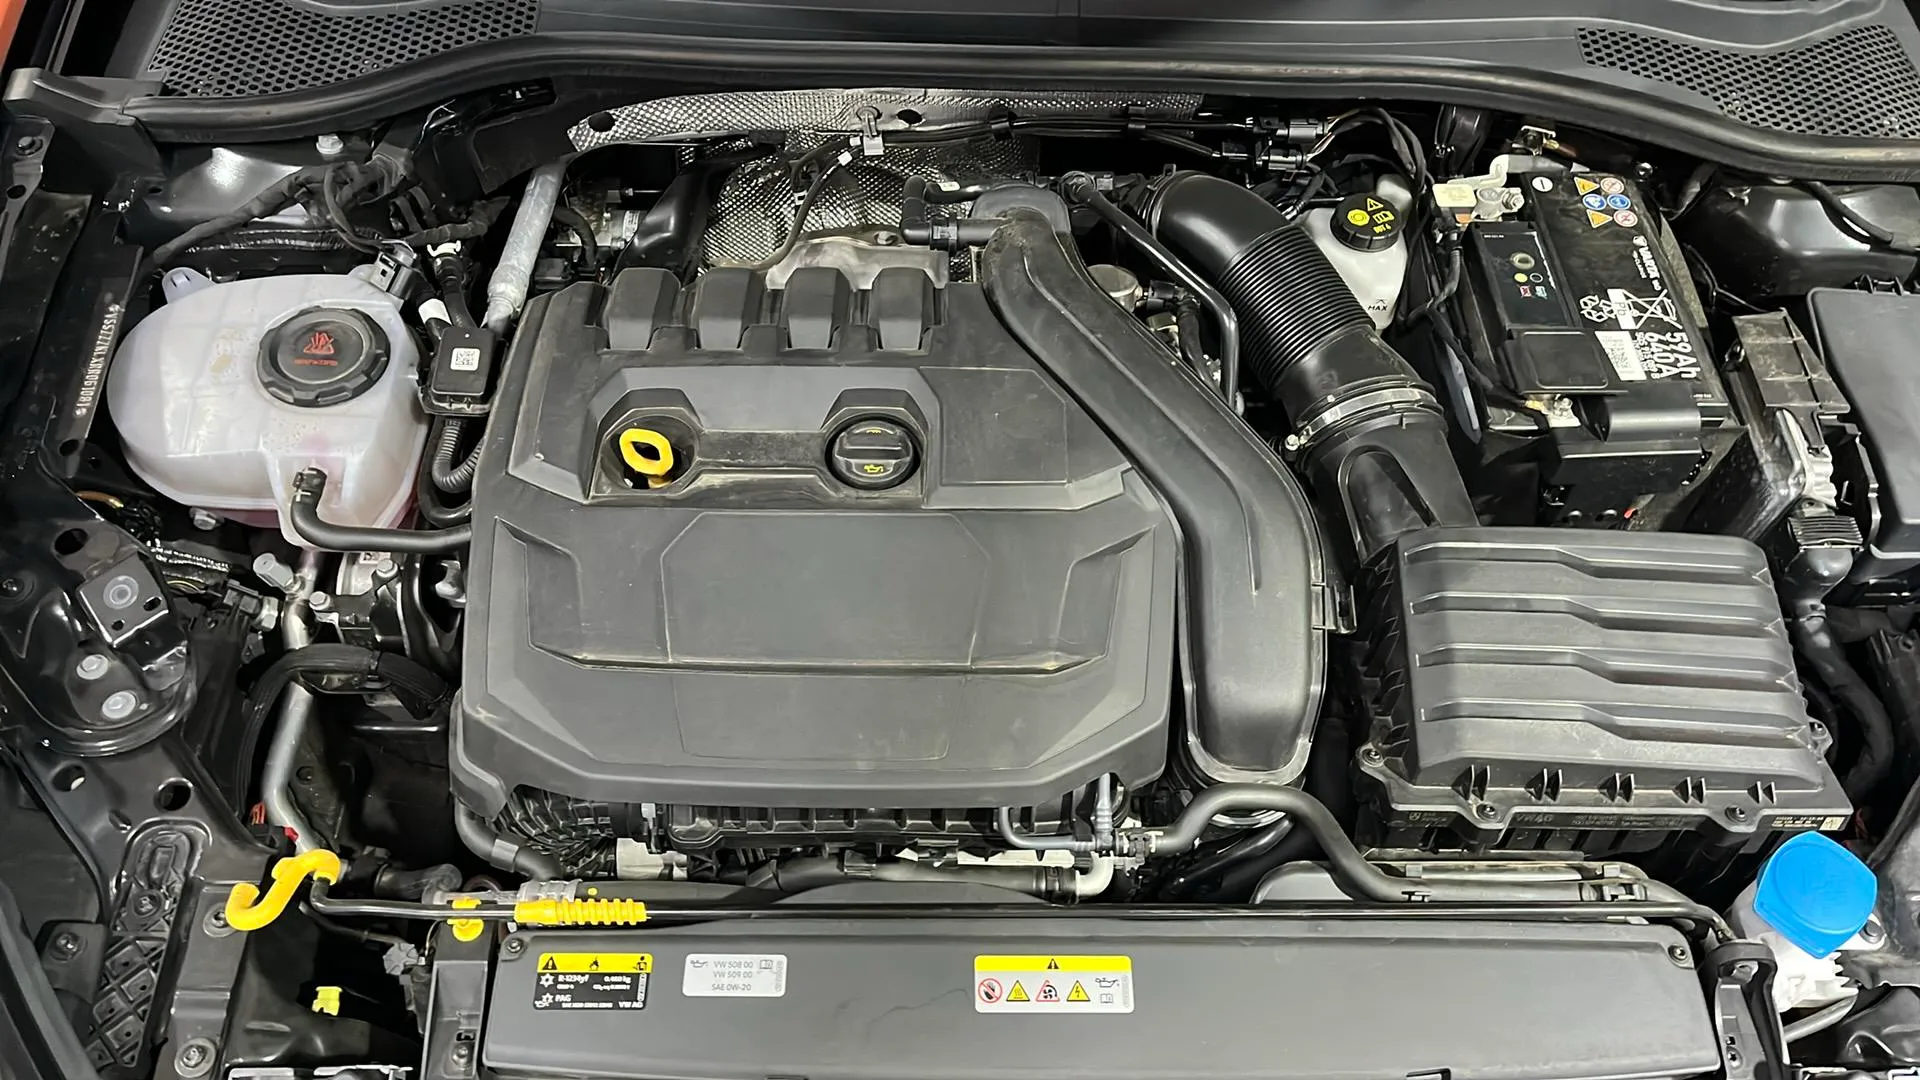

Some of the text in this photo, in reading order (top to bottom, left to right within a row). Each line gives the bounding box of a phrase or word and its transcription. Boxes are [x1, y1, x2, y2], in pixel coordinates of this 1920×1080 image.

[1639, 246, 1660, 279] VARTA
[1615, 301, 1627, 317] Pb
[1644, 331, 1681, 378] 640A
[1665, 331, 1701, 379] 59Ah
[713, 961, 727, 969] VW
[712, 971, 727, 979] VW
[711, 983, 752, 991] SAE 0W-20
[555, 994, 572, 1002] PAG
